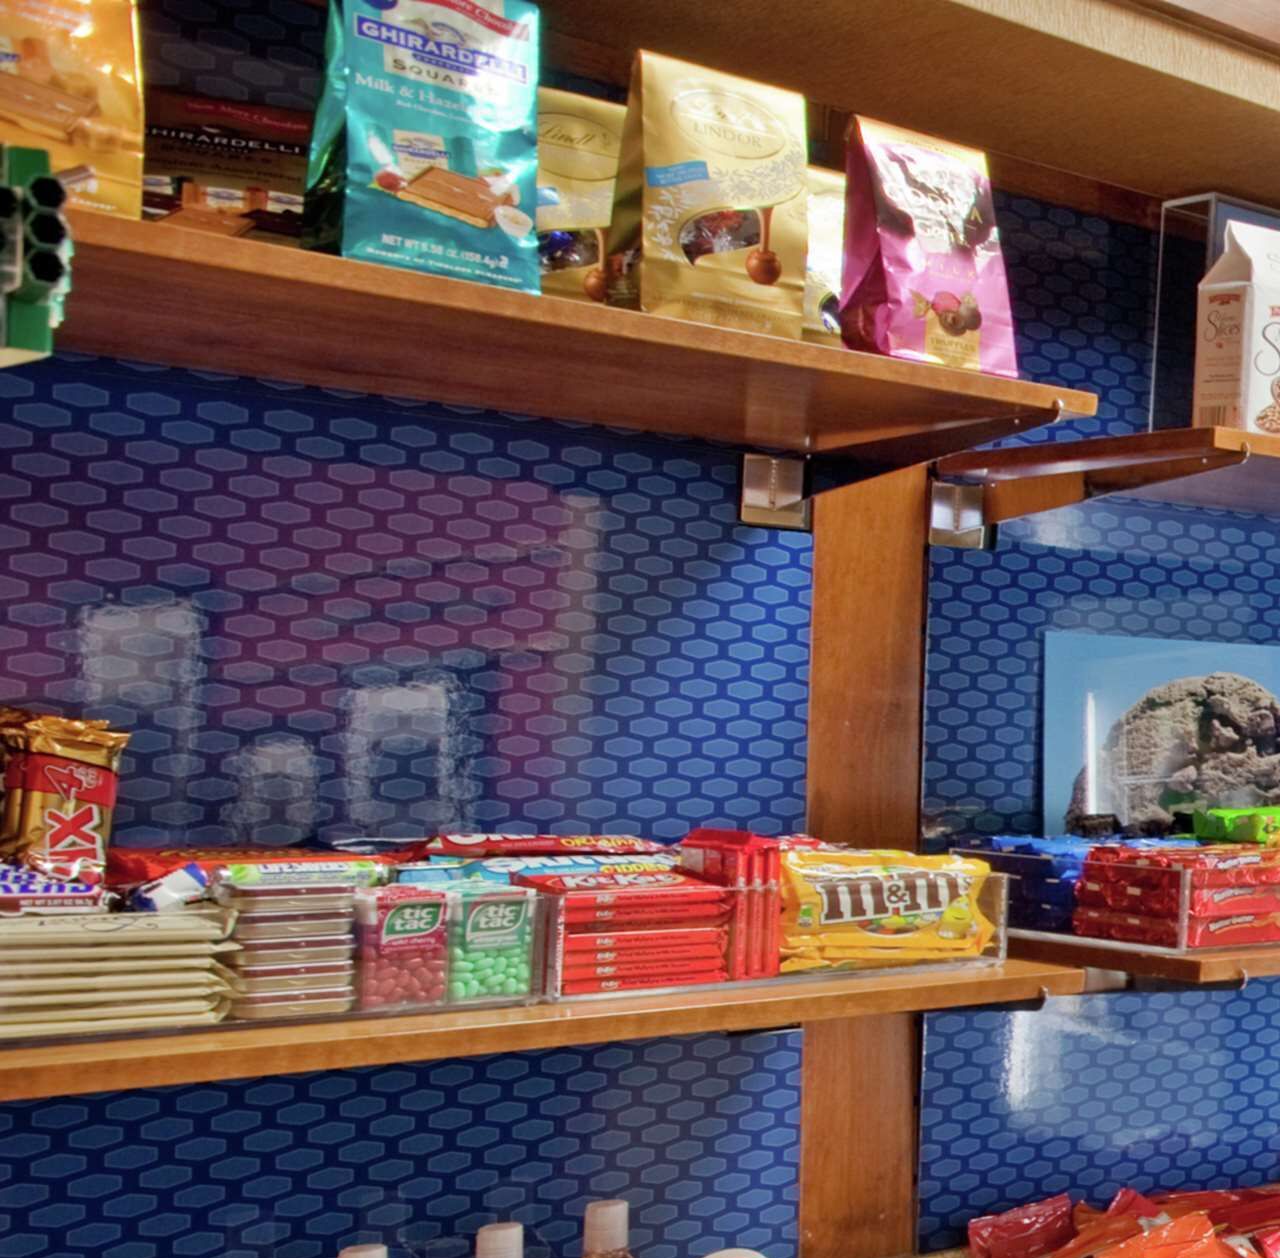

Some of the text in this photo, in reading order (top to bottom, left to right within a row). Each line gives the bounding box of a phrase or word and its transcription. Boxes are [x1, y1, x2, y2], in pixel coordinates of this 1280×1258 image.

[354, 73, 415, 98] Milk &
[146, 127, 300, 153] HIRARDELLI
[692, 123, 763, 149] LINDOR
[401, 905, 436, 919] tic
[486, 903, 515, 919] tic
[393, 916, 433, 931] tac
[478, 915, 514, 930] tac
